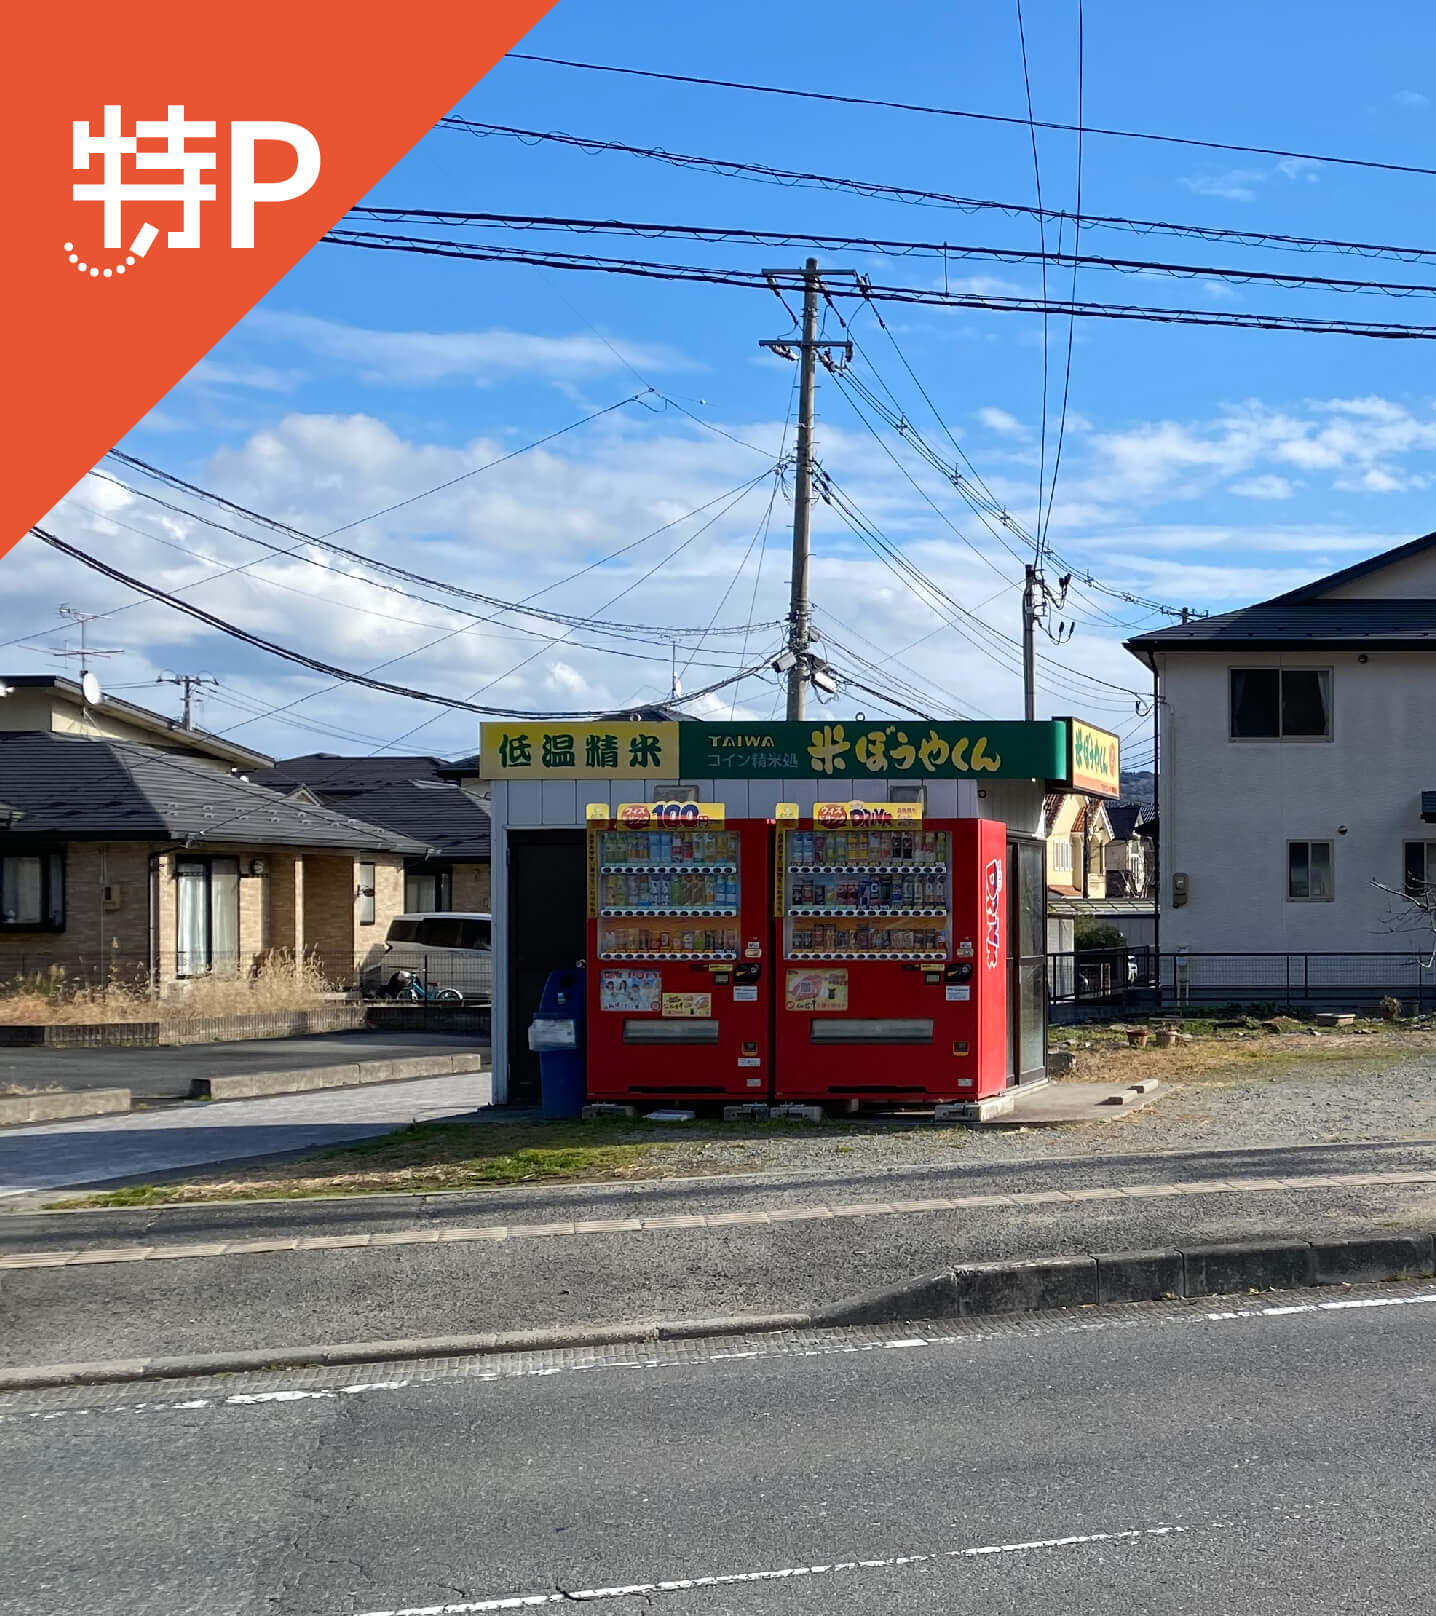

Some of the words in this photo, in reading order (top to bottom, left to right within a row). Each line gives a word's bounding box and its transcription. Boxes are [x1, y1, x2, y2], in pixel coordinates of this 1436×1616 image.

[498, 733, 662, 768] 低温精米
[708, 735, 775, 747] TAIWA
[808, 724, 1001, 774] 米ぼうやくん
[707, 752, 798, 768] コイン精米処
